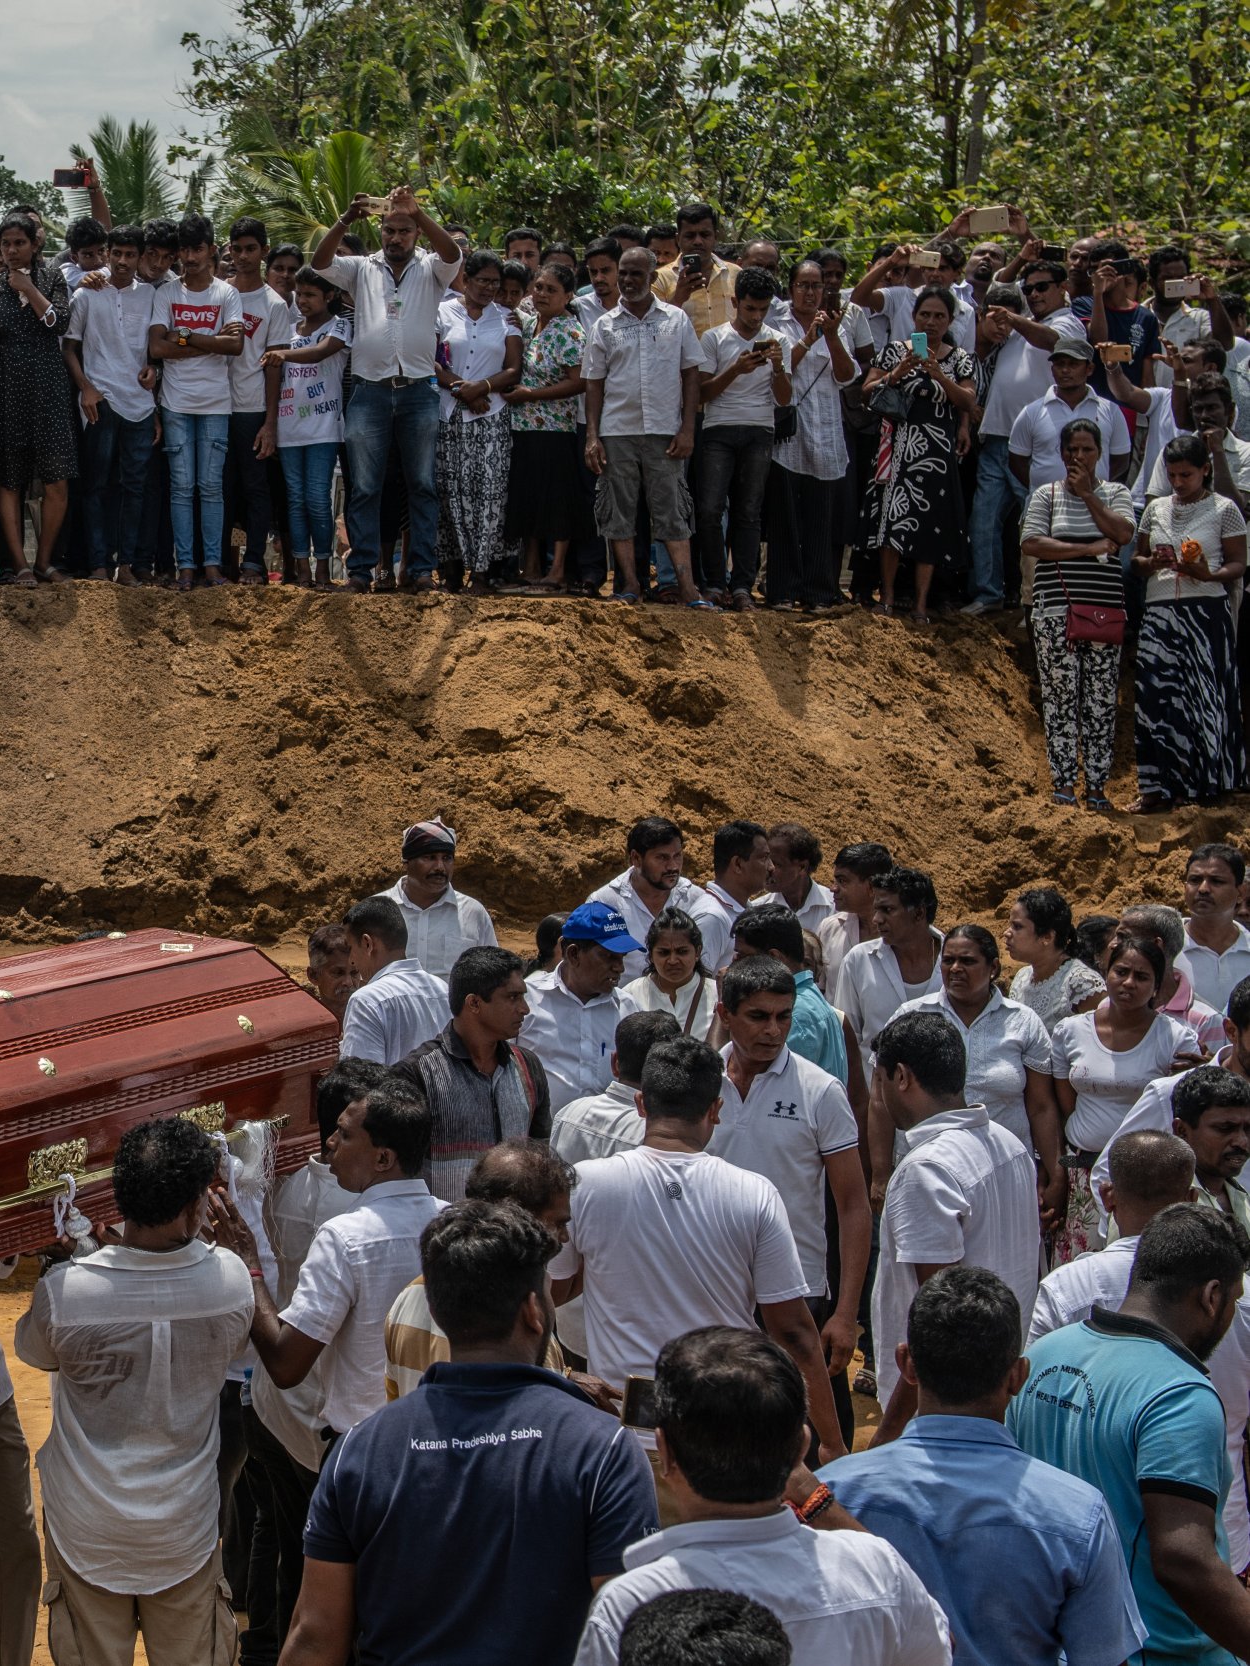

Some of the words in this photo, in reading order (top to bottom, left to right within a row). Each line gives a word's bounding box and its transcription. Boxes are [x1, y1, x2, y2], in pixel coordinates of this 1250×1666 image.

[306, 381, 326, 399] BUT
[298, 404, 310, 418] BY
[314, 398, 339, 415] HEART
[410, 1438, 448, 1450] Katana
[451, 1432, 507, 1449] Pradeshiya
[510, 1427, 543, 1440] Sabha
